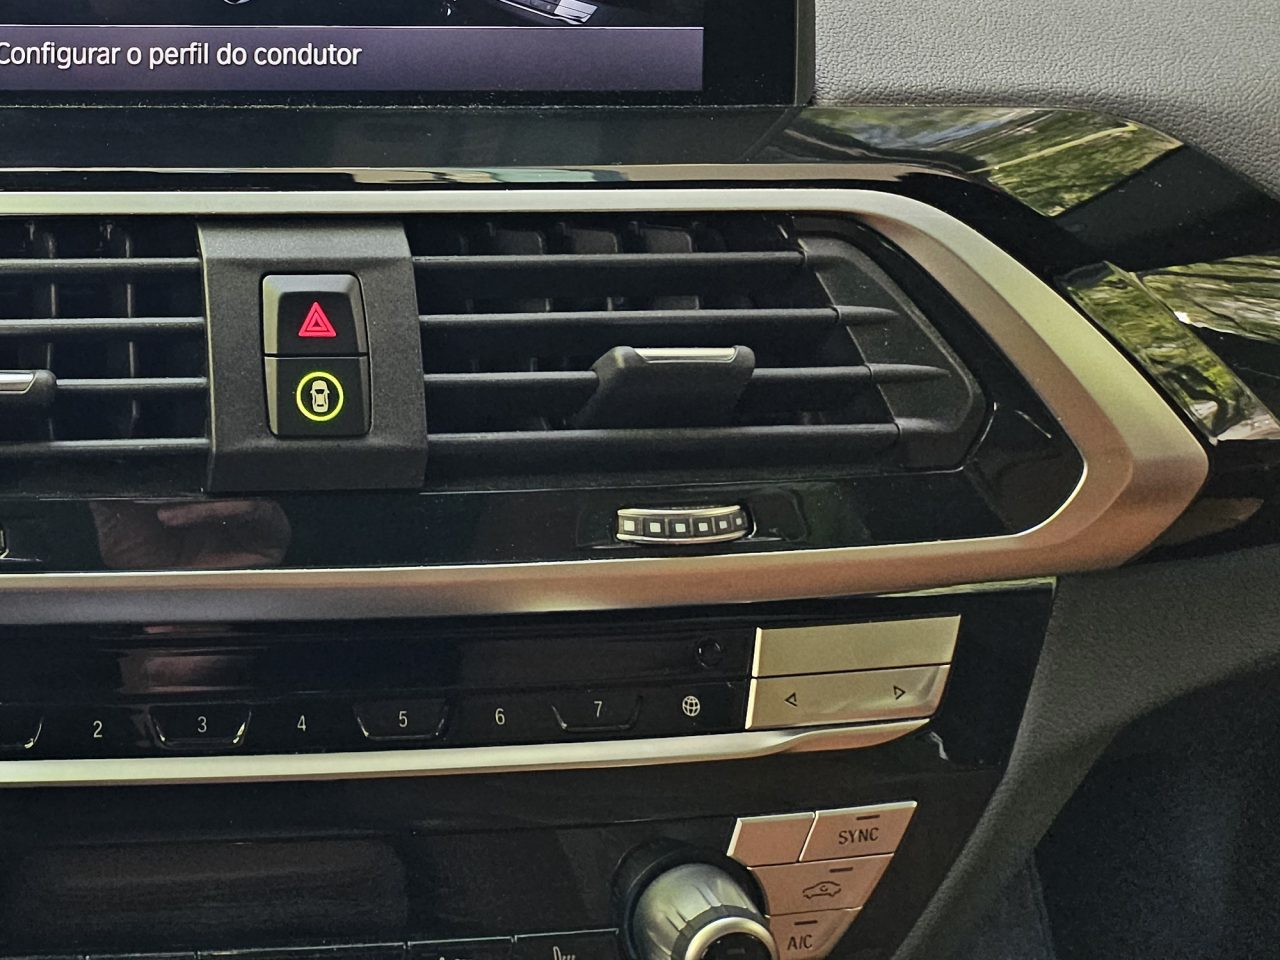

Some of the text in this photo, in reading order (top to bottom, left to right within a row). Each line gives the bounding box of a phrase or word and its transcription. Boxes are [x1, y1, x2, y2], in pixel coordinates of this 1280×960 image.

[126, 46, 142, 66] o
[149, 42, 209, 70] perfil
[216, 43, 247, 66] do
[253, 43, 363, 66] condutor
[494, 708, 505, 726] 6
[593, 700, 603, 718] 7
[197, 716, 207, 733] 3
[296, 714, 307, 732] 4
[398, 710, 408, 728] 5
[92, 720, 103, 738] 2
[838, 827, 880, 845] SYNC
[787, 934, 813, 950] A/C
